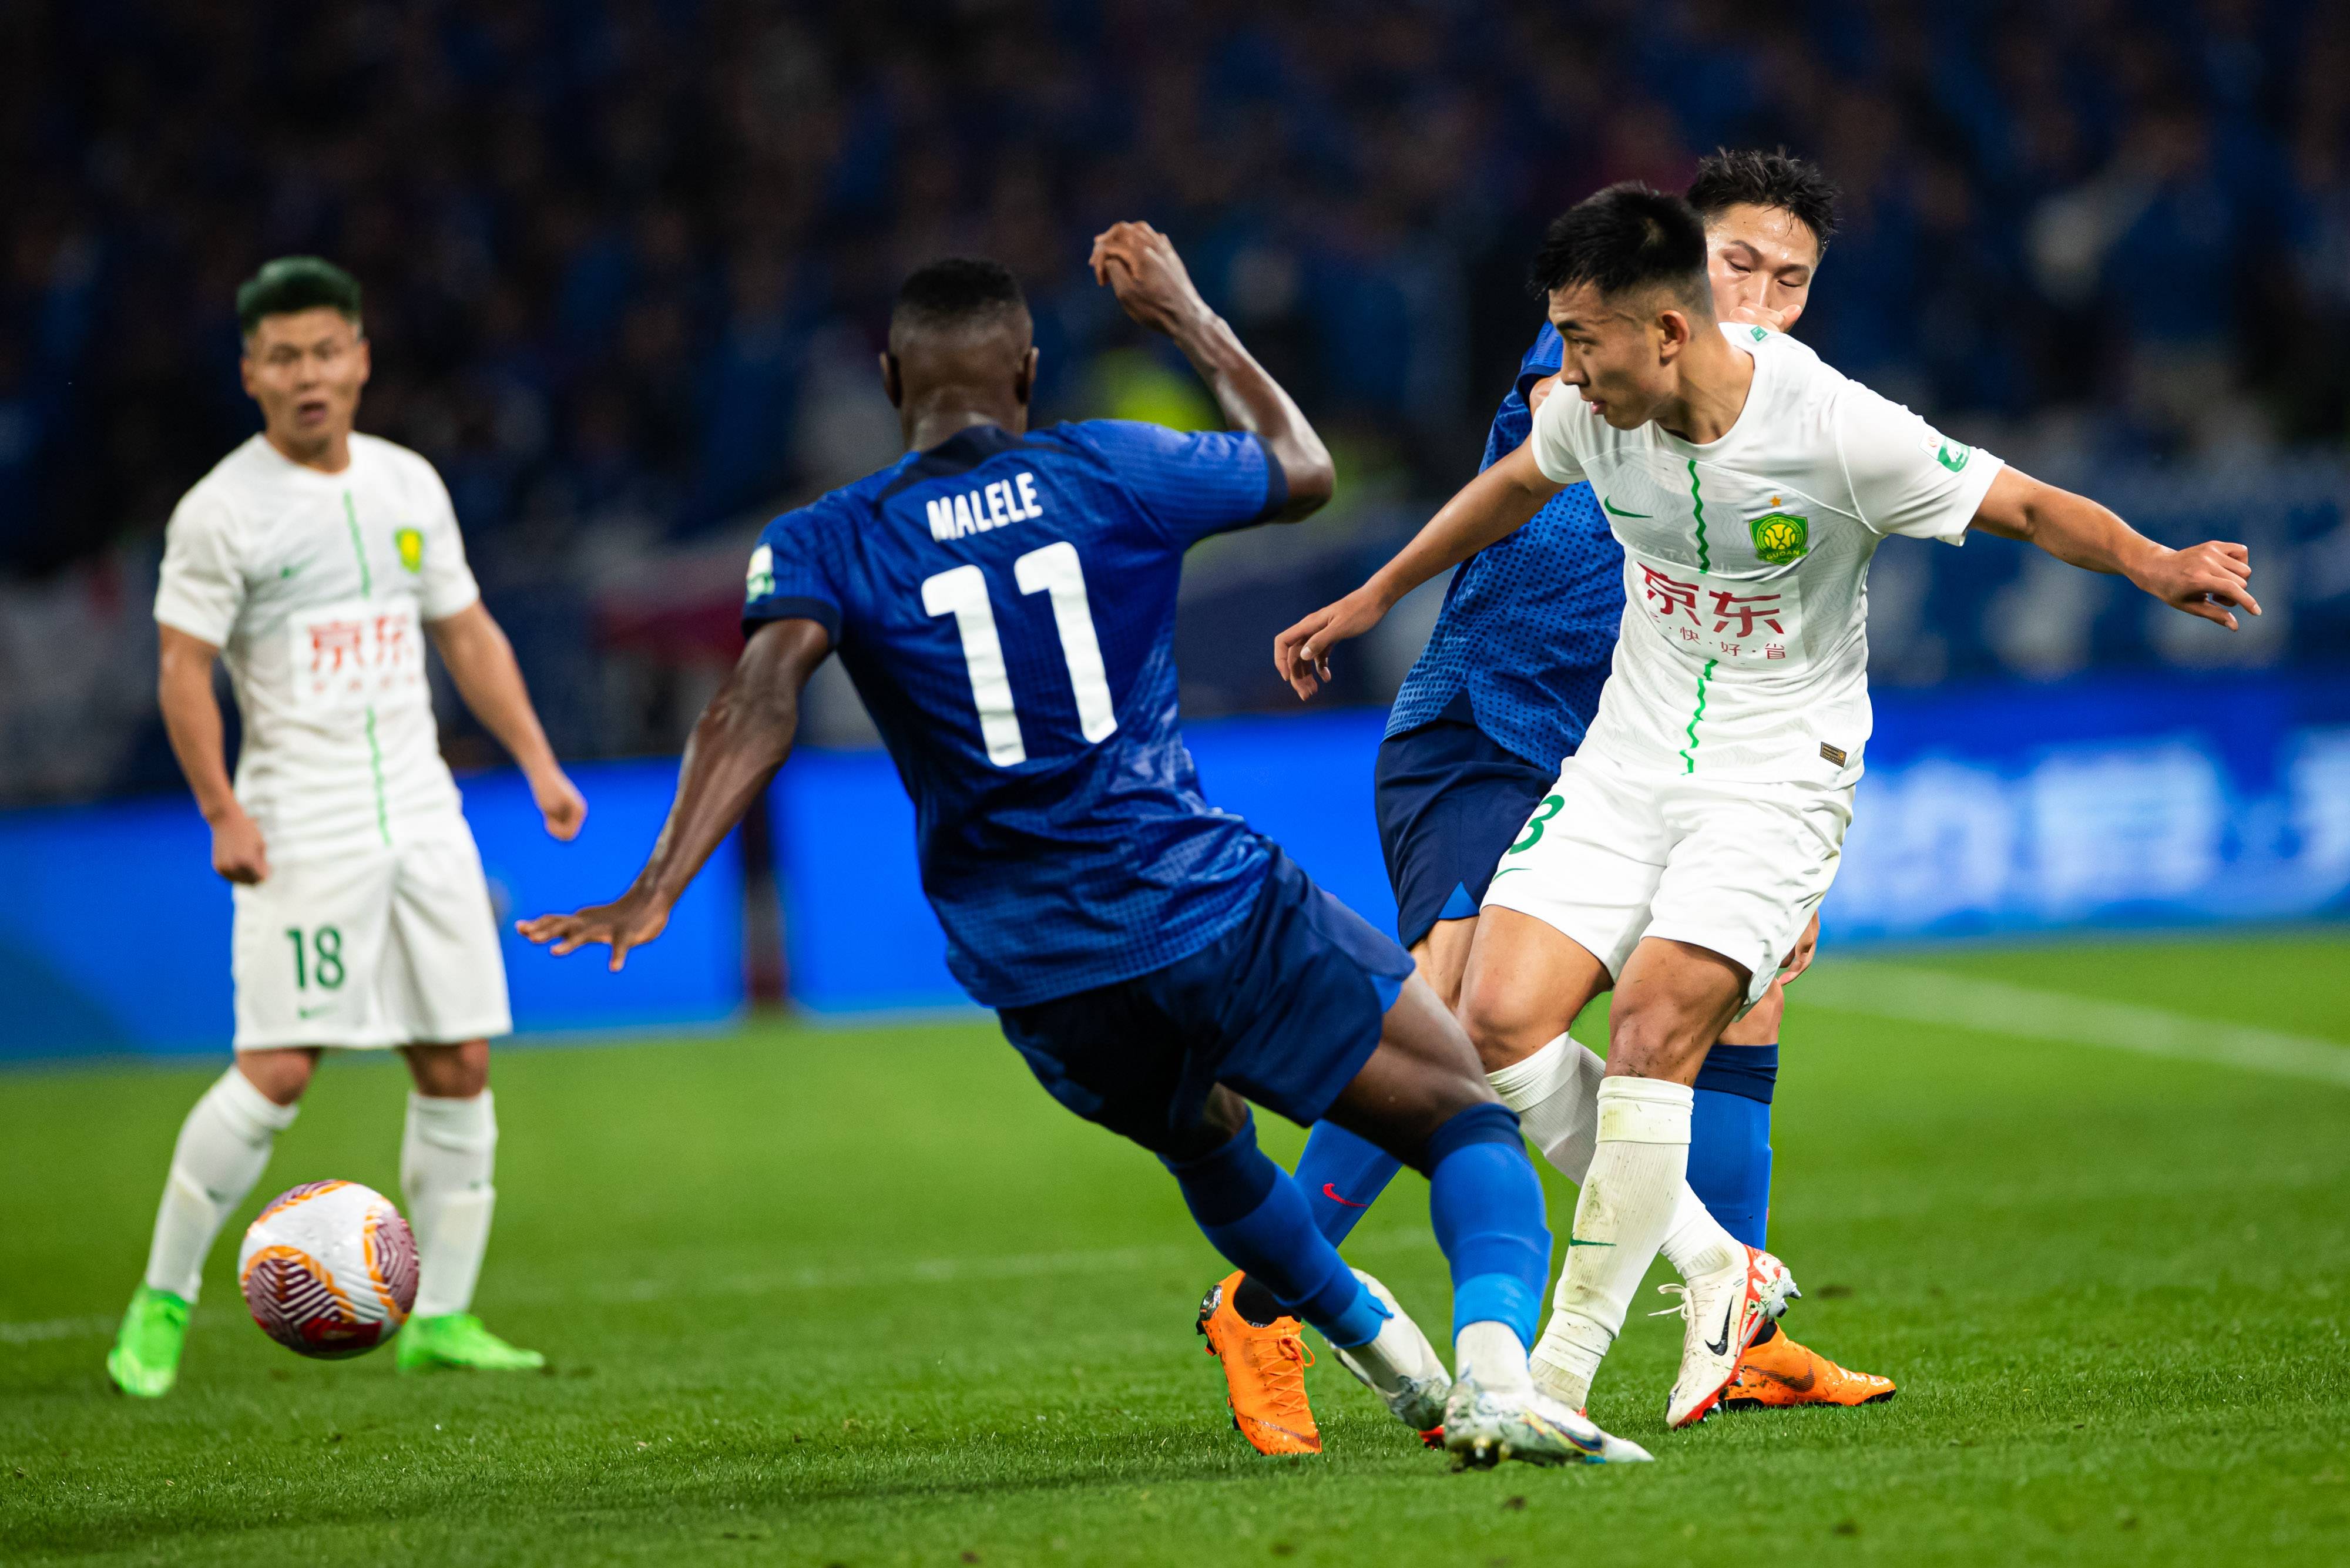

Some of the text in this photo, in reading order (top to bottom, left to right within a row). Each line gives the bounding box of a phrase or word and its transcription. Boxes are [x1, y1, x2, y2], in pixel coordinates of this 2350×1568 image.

[926, 472, 1043, 542] MALELE
[1637, 561, 1785, 638] 京东
[921, 541, 1118, 767] 11
[1508, 795, 1565, 855] 3
[285, 925, 345, 991] 18
